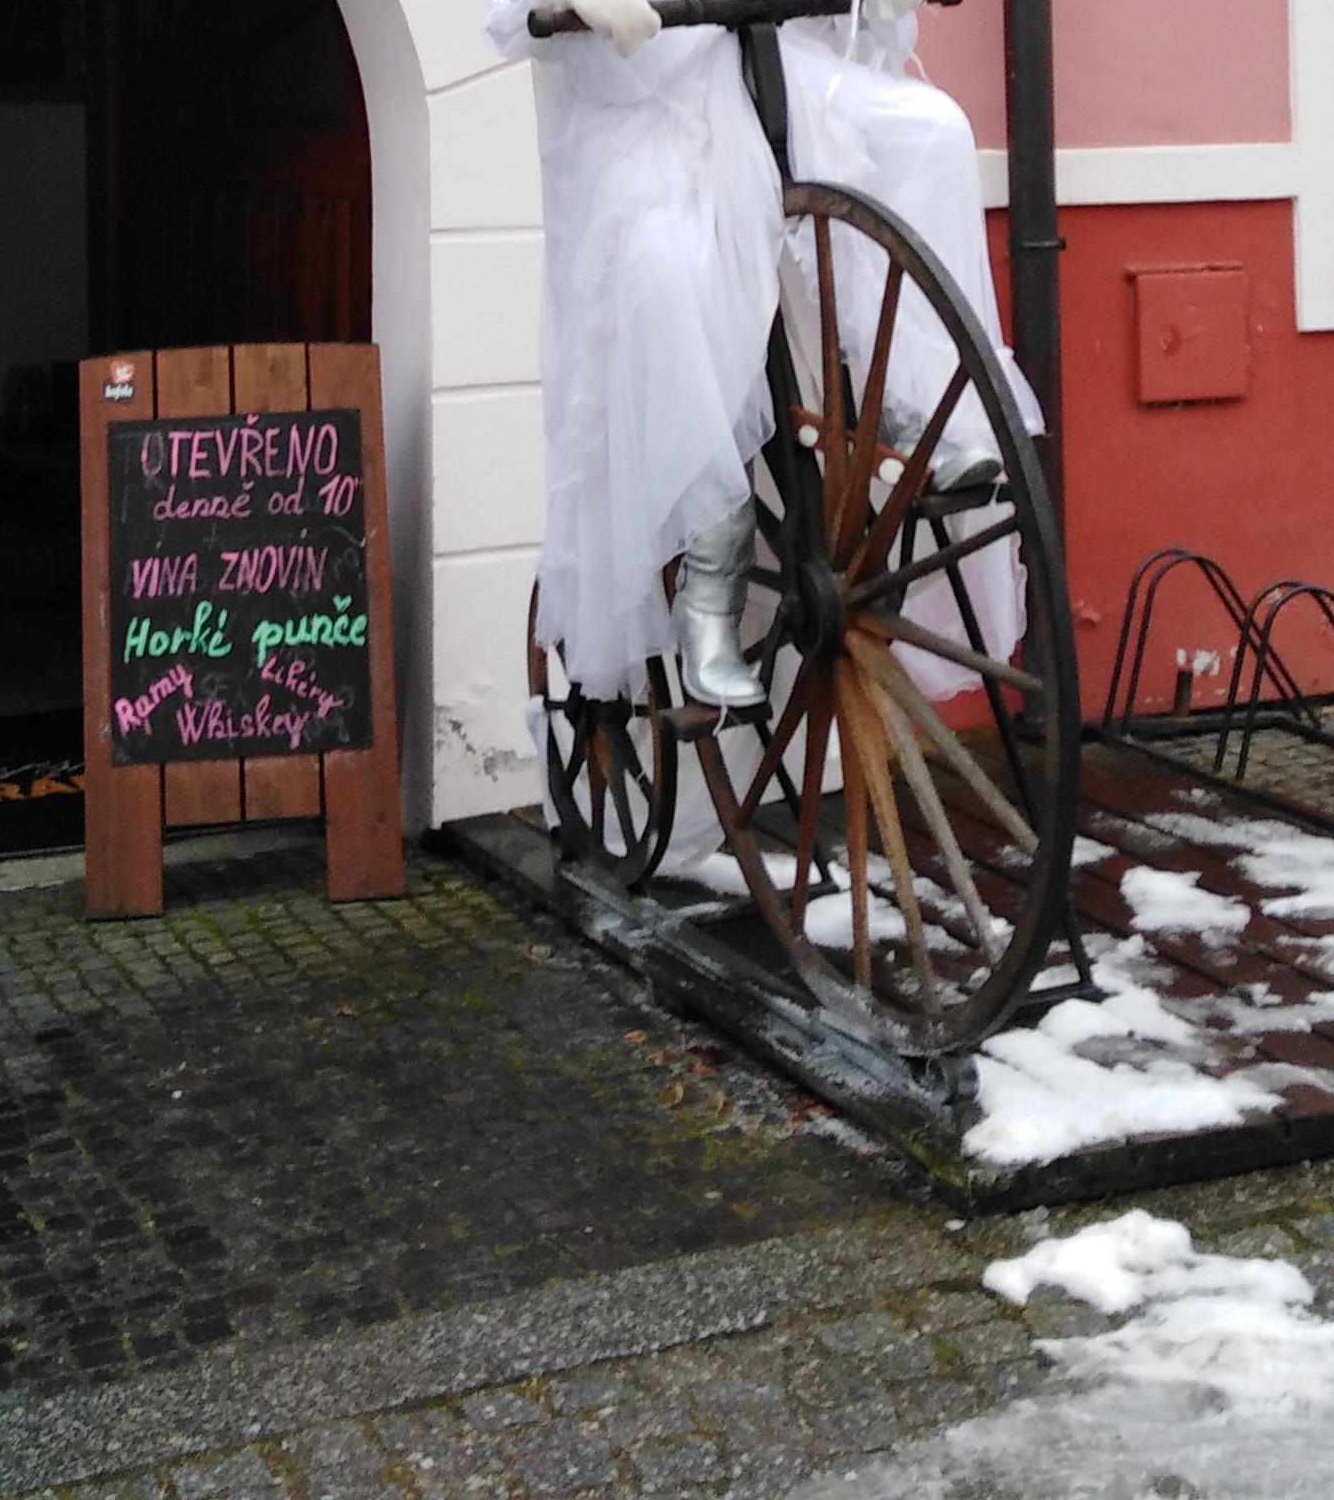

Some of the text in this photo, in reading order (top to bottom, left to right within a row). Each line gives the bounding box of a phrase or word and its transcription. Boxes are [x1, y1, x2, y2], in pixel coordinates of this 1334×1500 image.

[140, 414, 339, 479] OTEVŘENO
[153, 480, 256, 521] denně
[267, 475, 305, 516] od
[131, 540, 198, 599] VÍNA
[123, 594, 368, 668] Horké punče
[176, 693, 310, 750] Whiskey
